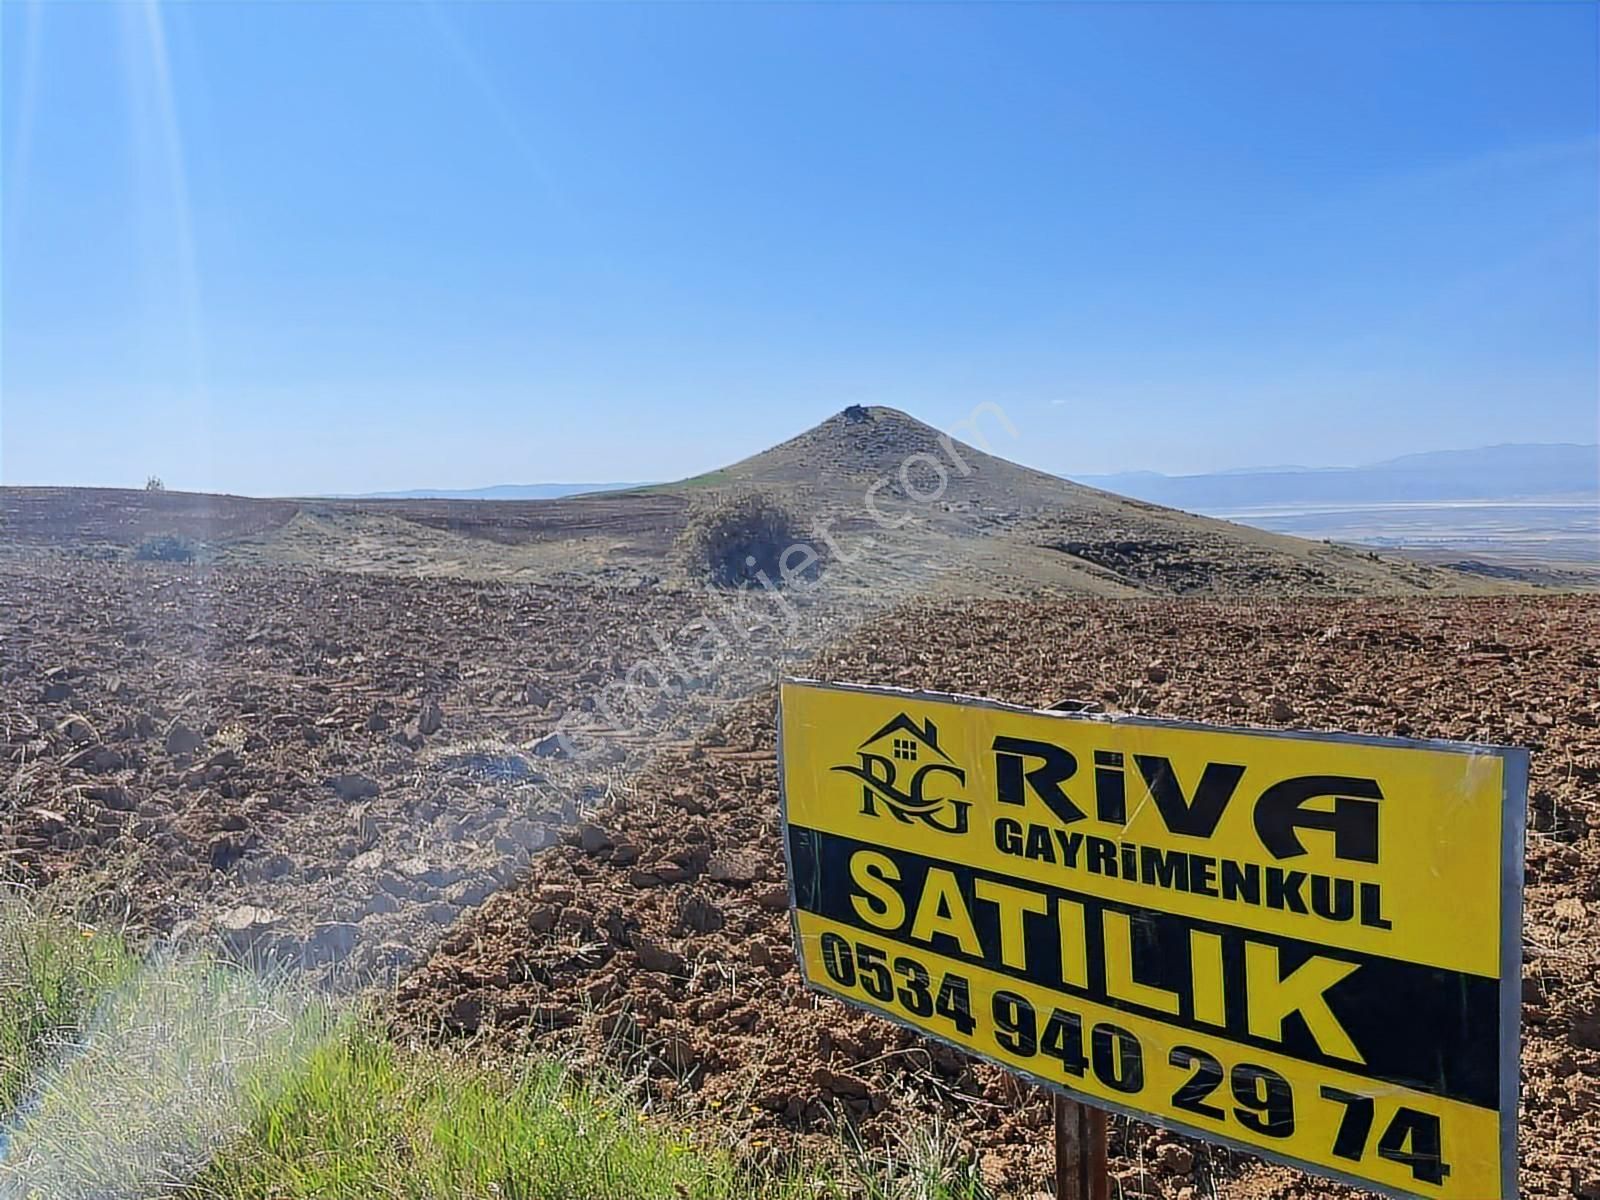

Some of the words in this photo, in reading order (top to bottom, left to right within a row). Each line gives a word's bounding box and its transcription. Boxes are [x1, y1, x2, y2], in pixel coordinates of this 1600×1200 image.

[821, 932, 975, 1035] 0534
[992, 990, 1143, 1093] 940
[1168, 1045, 1294, 1138] 29
[1320, 1086, 1450, 1185] 74
[849, 850, 1366, 1065] SATILIK
